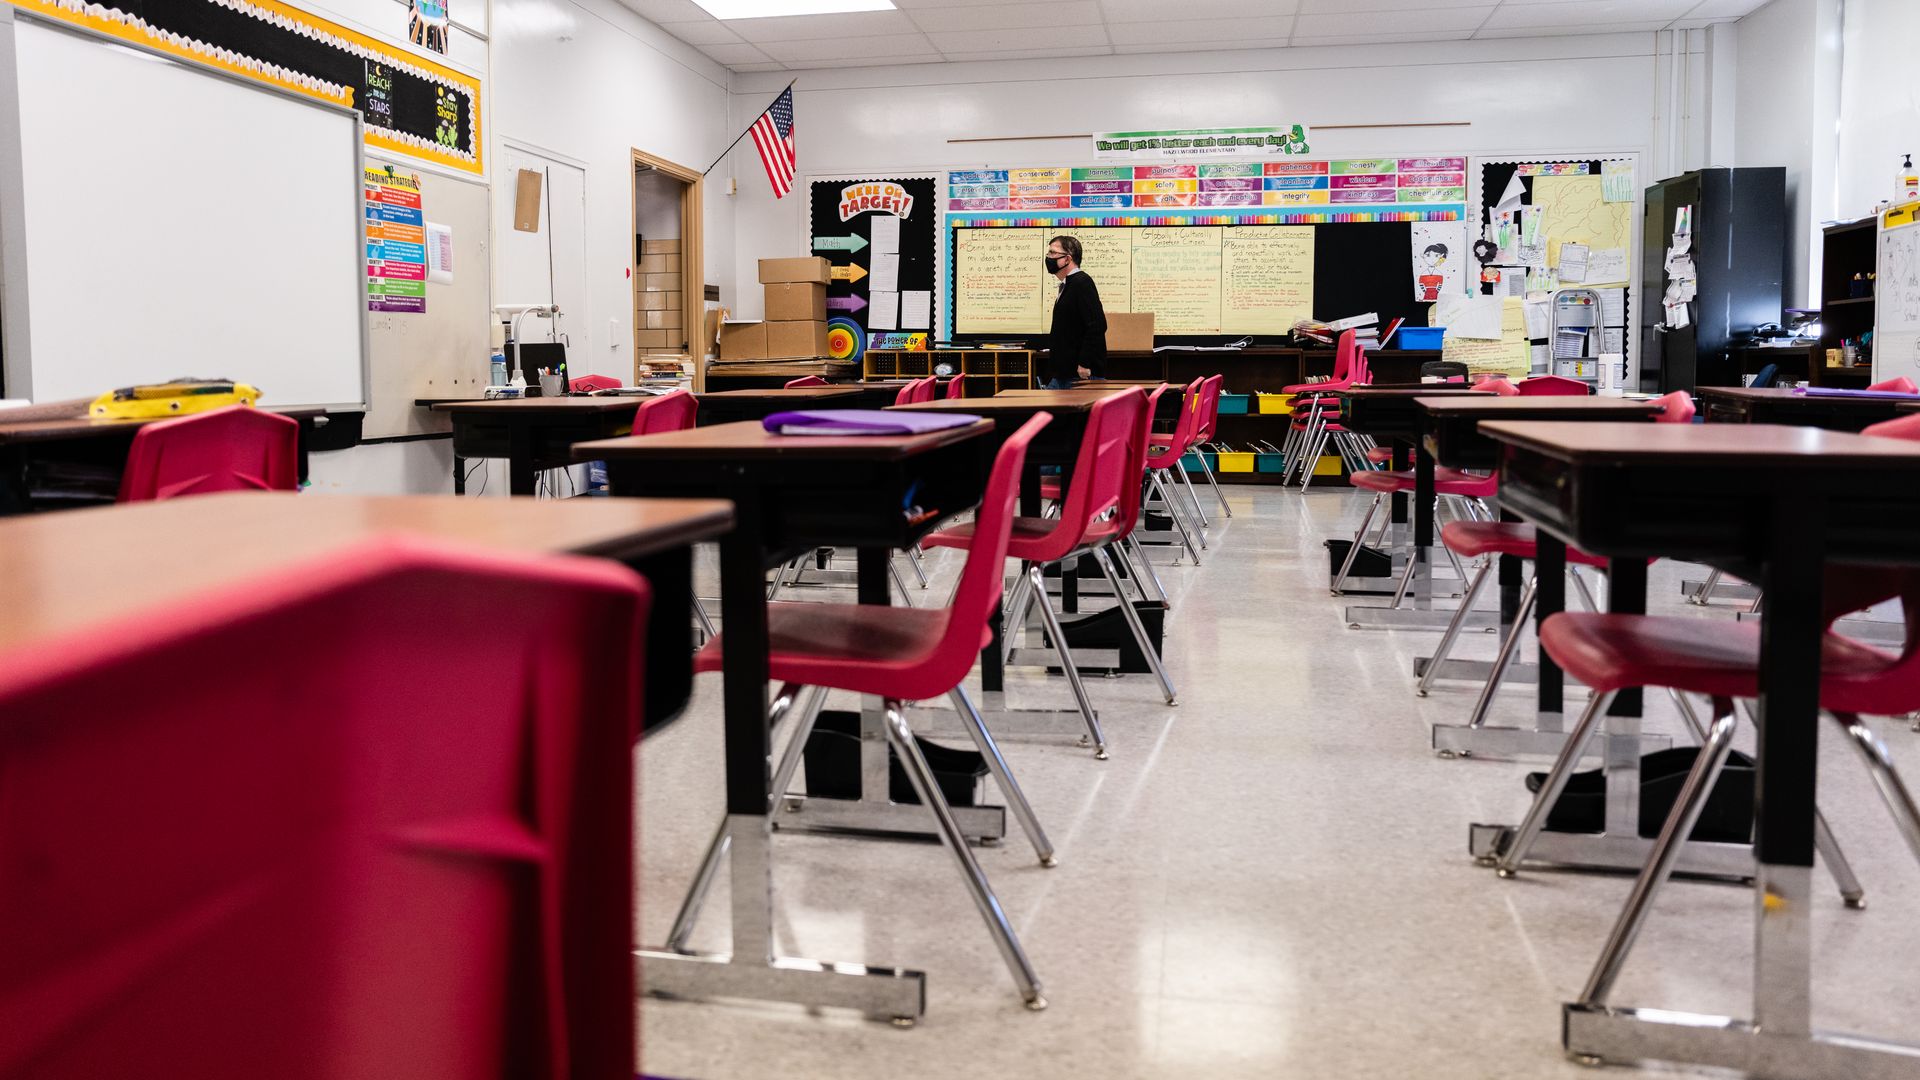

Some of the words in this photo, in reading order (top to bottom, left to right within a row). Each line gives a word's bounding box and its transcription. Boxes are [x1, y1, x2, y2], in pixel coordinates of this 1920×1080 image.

[368, 74, 390, 91] REACH
[370, 98, 391, 115] STARS
[443, 97, 457, 113] Stay
[437, 105, 458, 123] Sharp
[1096, 141, 1112, 151] We
[1112, 140, 1129, 150] will
[1130, 140, 1147, 152] get
[1148, 139, 1161, 149] 1%
[1162, 139, 1192, 149] better
[1193, 136, 1216, 147] each
[1217, 136, 1236, 146] and
[1237, 137, 1264, 147] every
[1265, 135, 1287, 147] day!
[1018, 170, 1060, 178] conservation
[389, 176, 417, 189] STRATEGIE
[1155, 182, 1175, 190] safety
[885, 185, 903, 199] ON
[1204, 192, 1258, 201] conication
[1281, 192, 1310, 201] integrity
[1346, 190, 1379, 198] kindness
[841, 195, 911, 218] TARGET!
[1021, 198, 1058, 206] forgiveness
[1180, 227, 1213, 240] Culturally
[822, 238, 841, 249] Math
